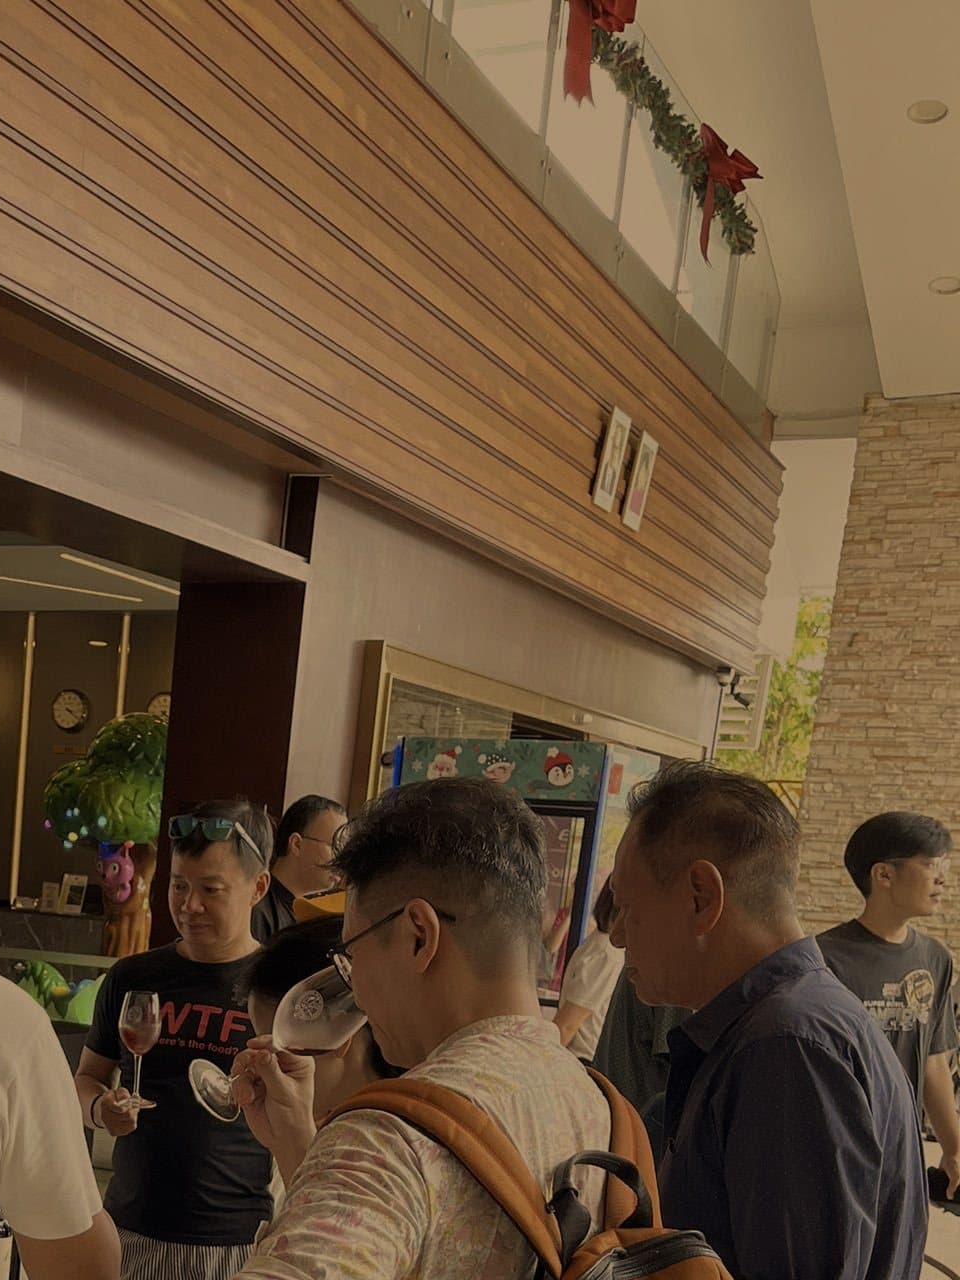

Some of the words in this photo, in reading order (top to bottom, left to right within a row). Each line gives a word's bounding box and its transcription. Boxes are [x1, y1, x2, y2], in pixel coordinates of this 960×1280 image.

[151, 1000, 250, 1042] WTF
[187, 1039, 206, 1050] the
[207, 1043, 239, 1056] food?
